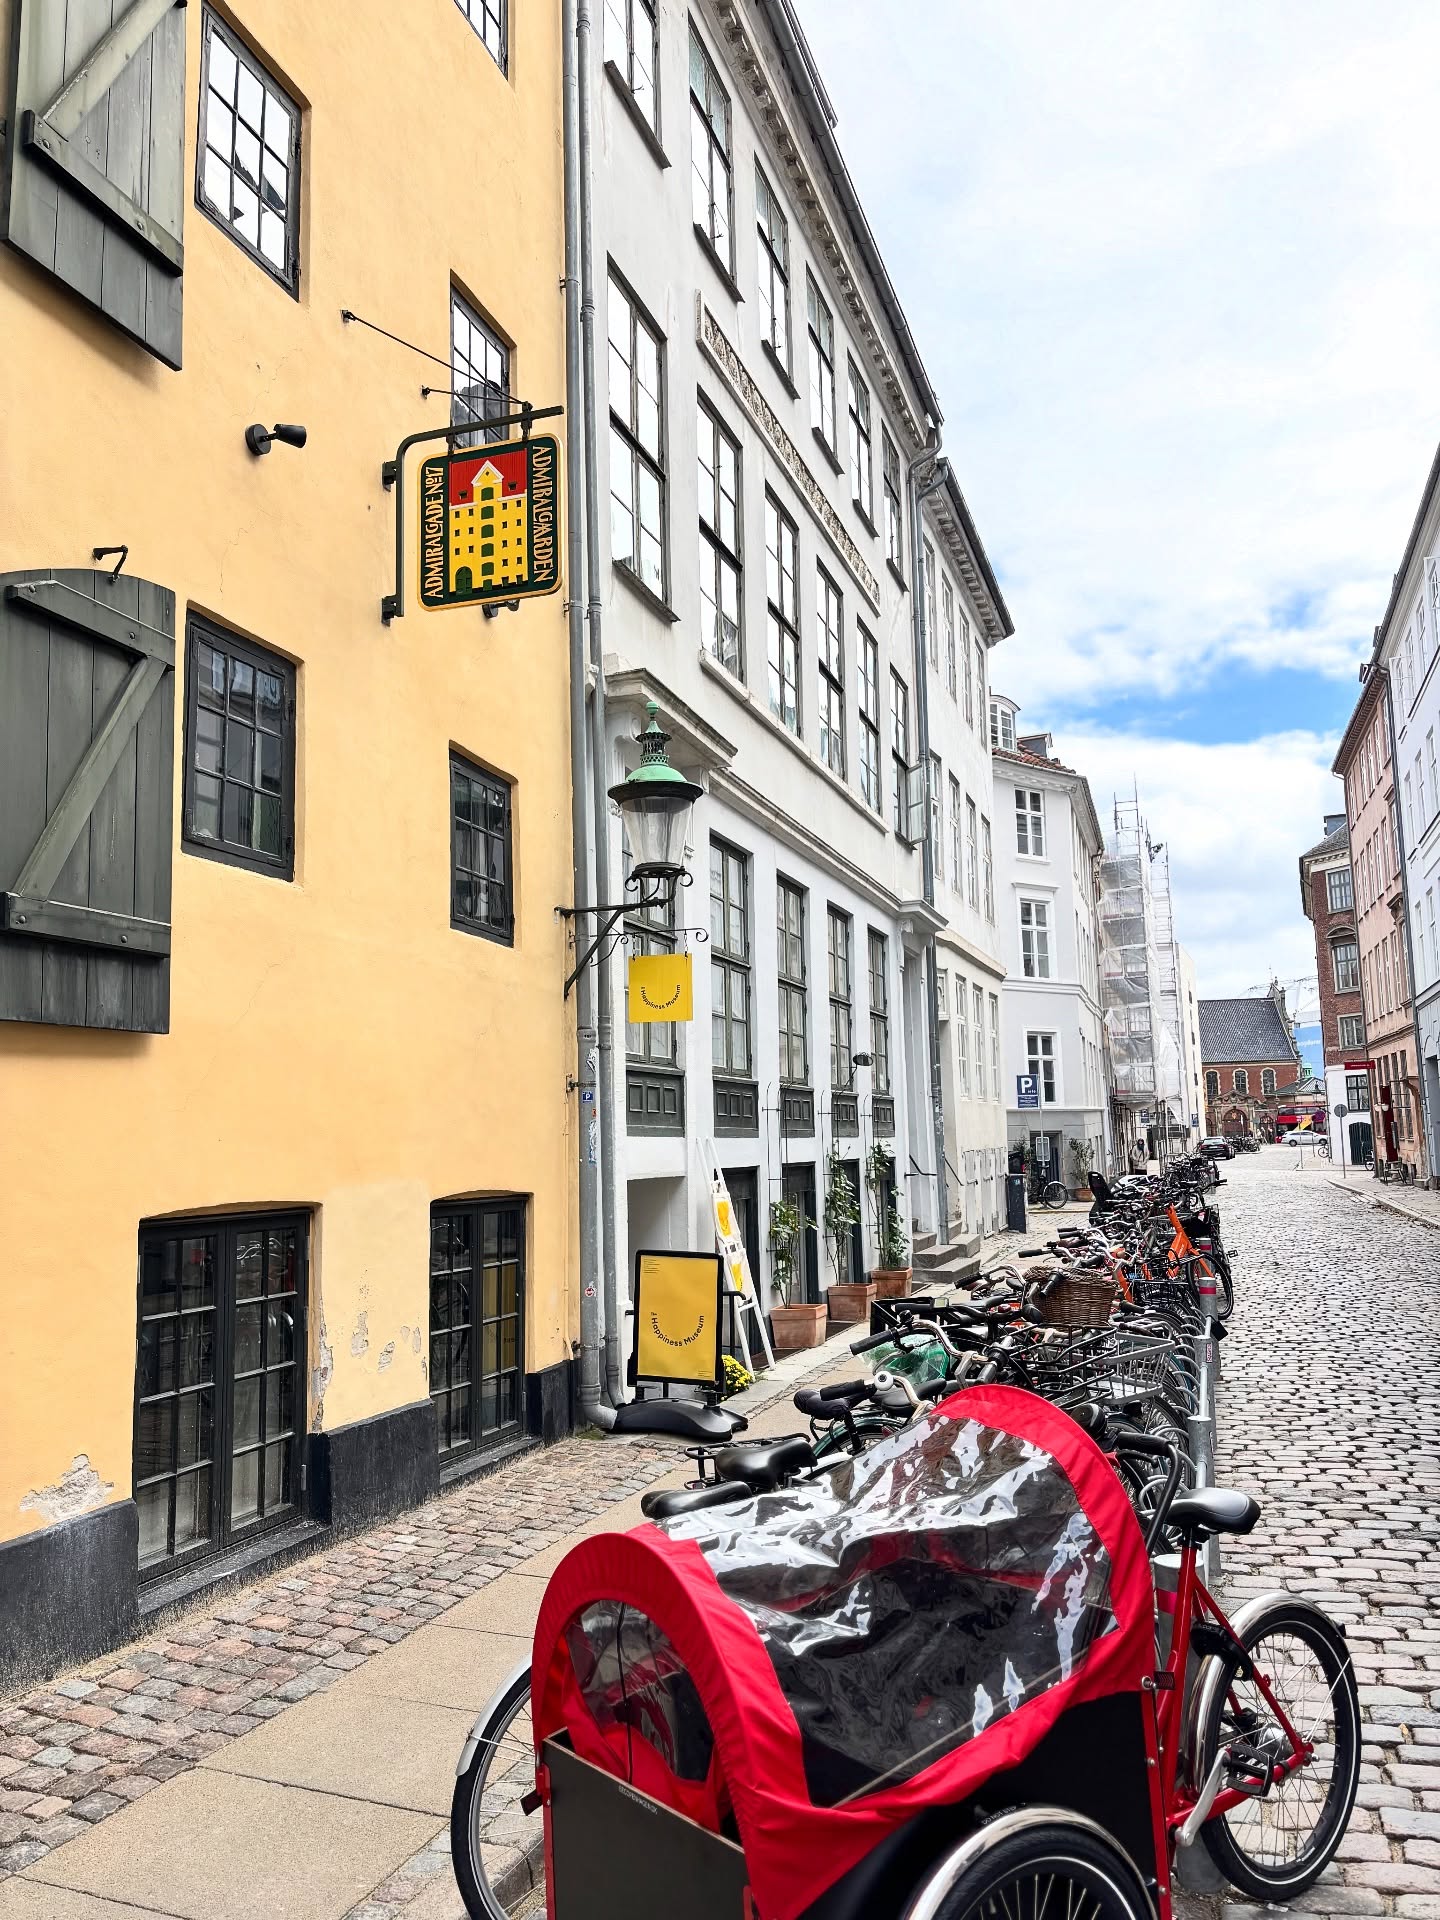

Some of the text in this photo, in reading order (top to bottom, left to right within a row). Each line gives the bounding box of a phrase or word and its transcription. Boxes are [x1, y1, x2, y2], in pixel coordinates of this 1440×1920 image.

[424, 495, 444, 599] ADMIRALGADE
[640, 984, 681, 1010] Happiness Museum
[1020, 1077, 1033, 1094] P
[651, 1317, 683, 1347] Happiness
[683, 1315, 705, 1346] Museum
